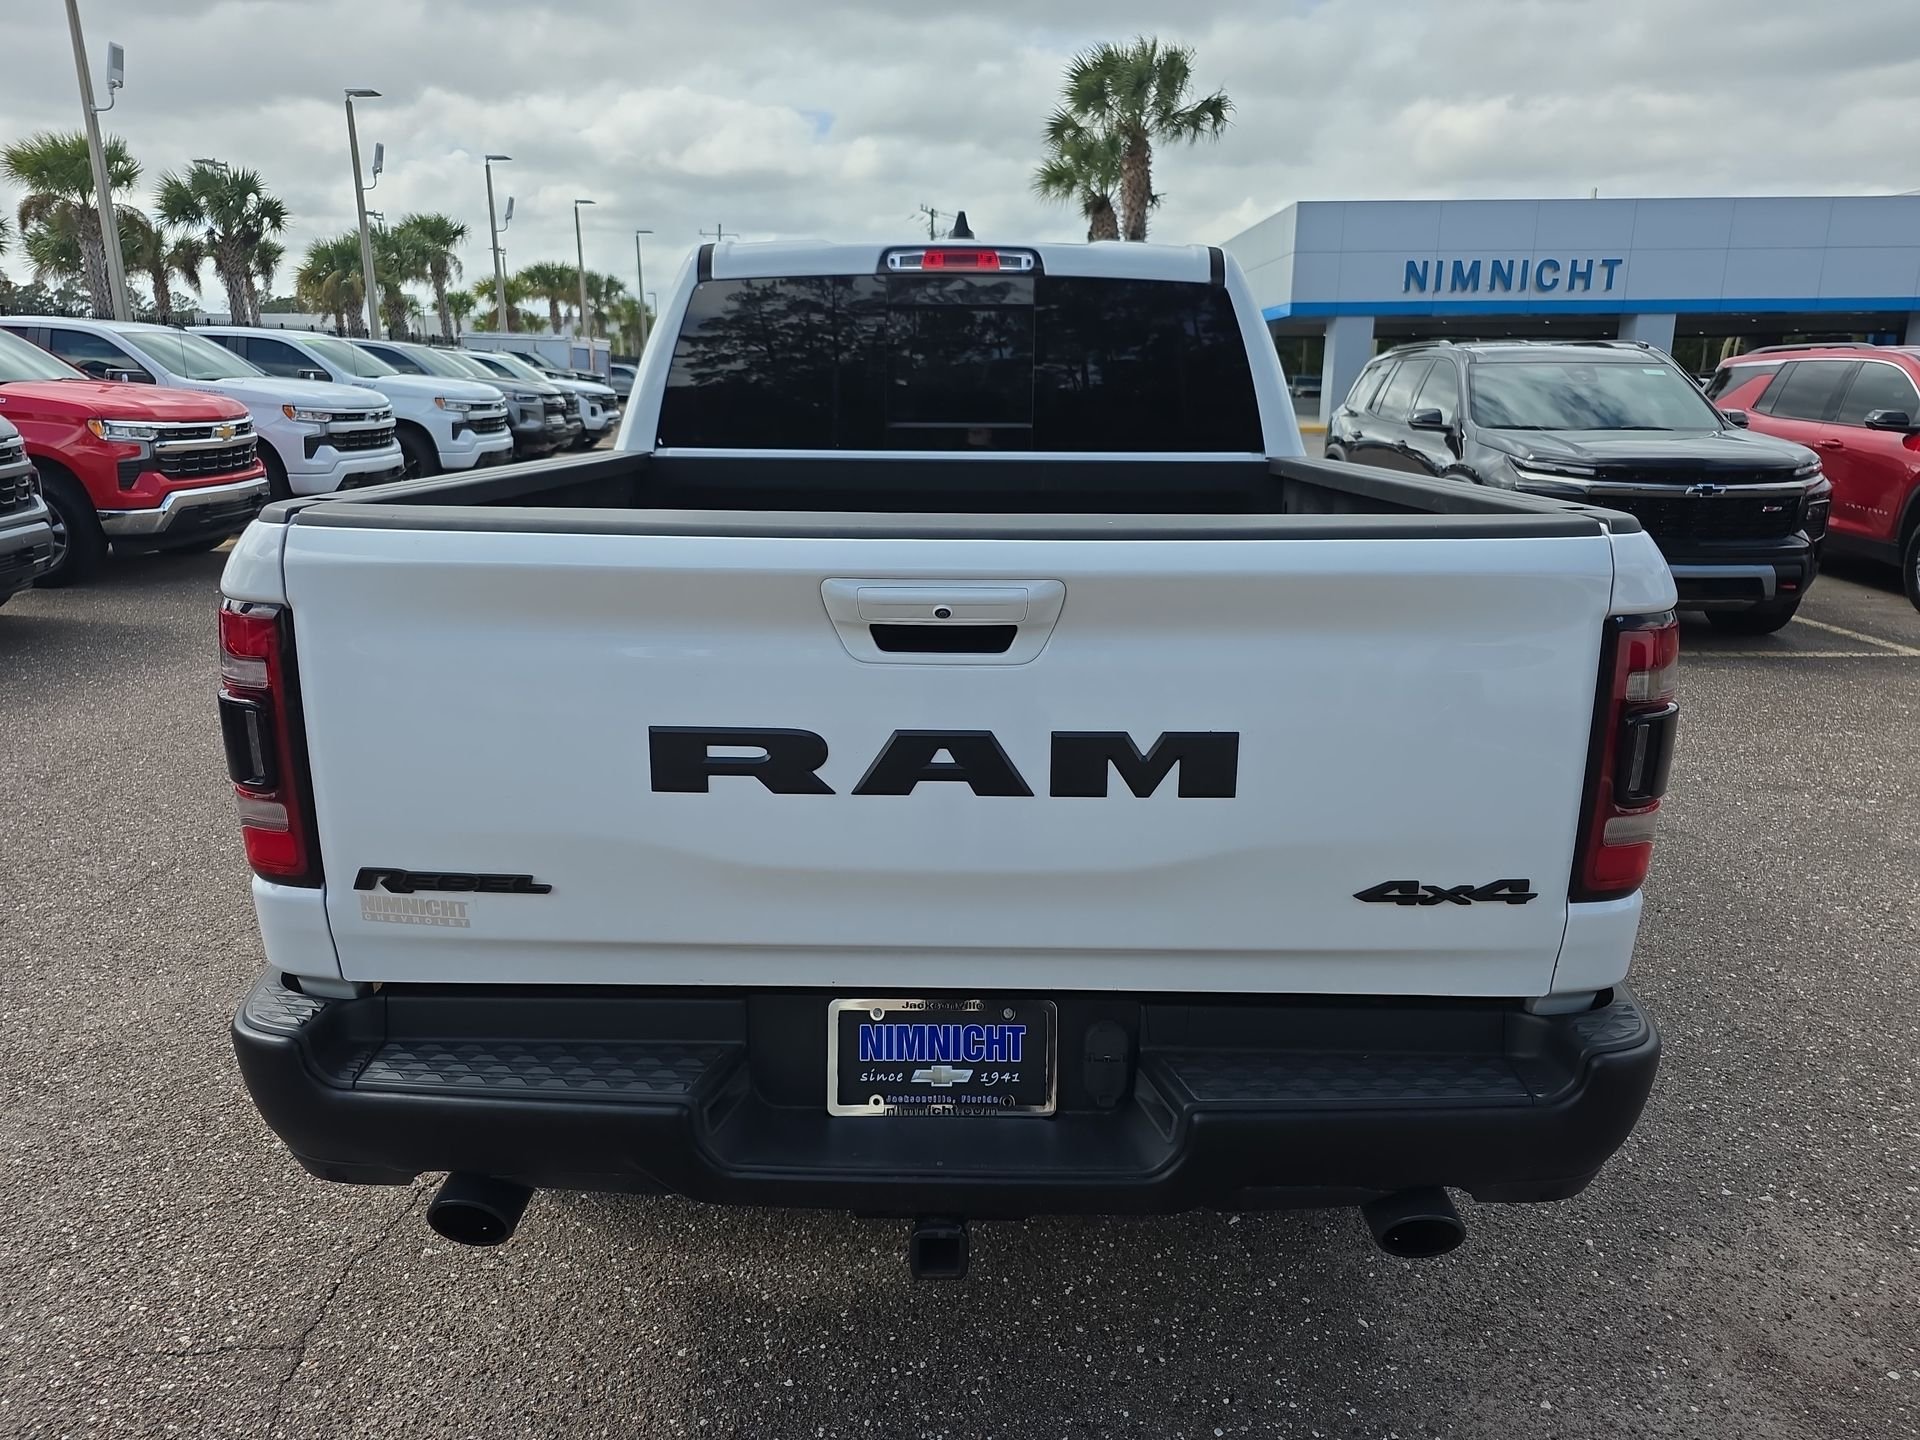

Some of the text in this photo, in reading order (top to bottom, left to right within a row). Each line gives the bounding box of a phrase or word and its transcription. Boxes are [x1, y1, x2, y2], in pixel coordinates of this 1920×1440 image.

[1403, 258, 1623, 292] NIMNICHT
[648, 726, 1240, 799] RAM
[353, 867, 552, 894] REBEL
[1352, 878, 1539, 905] 4x4
[360, 894, 469, 918] NIMNICHT
[364, 913, 468, 928] CHEVROLET
[902, 1000, 986, 1011] Jacksonville
[859, 1024, 1027, 1063] NIMNICHT
[859, 1068, 1021, 1087] since 1941
[960, 1094, 1000, 1104] Florida
